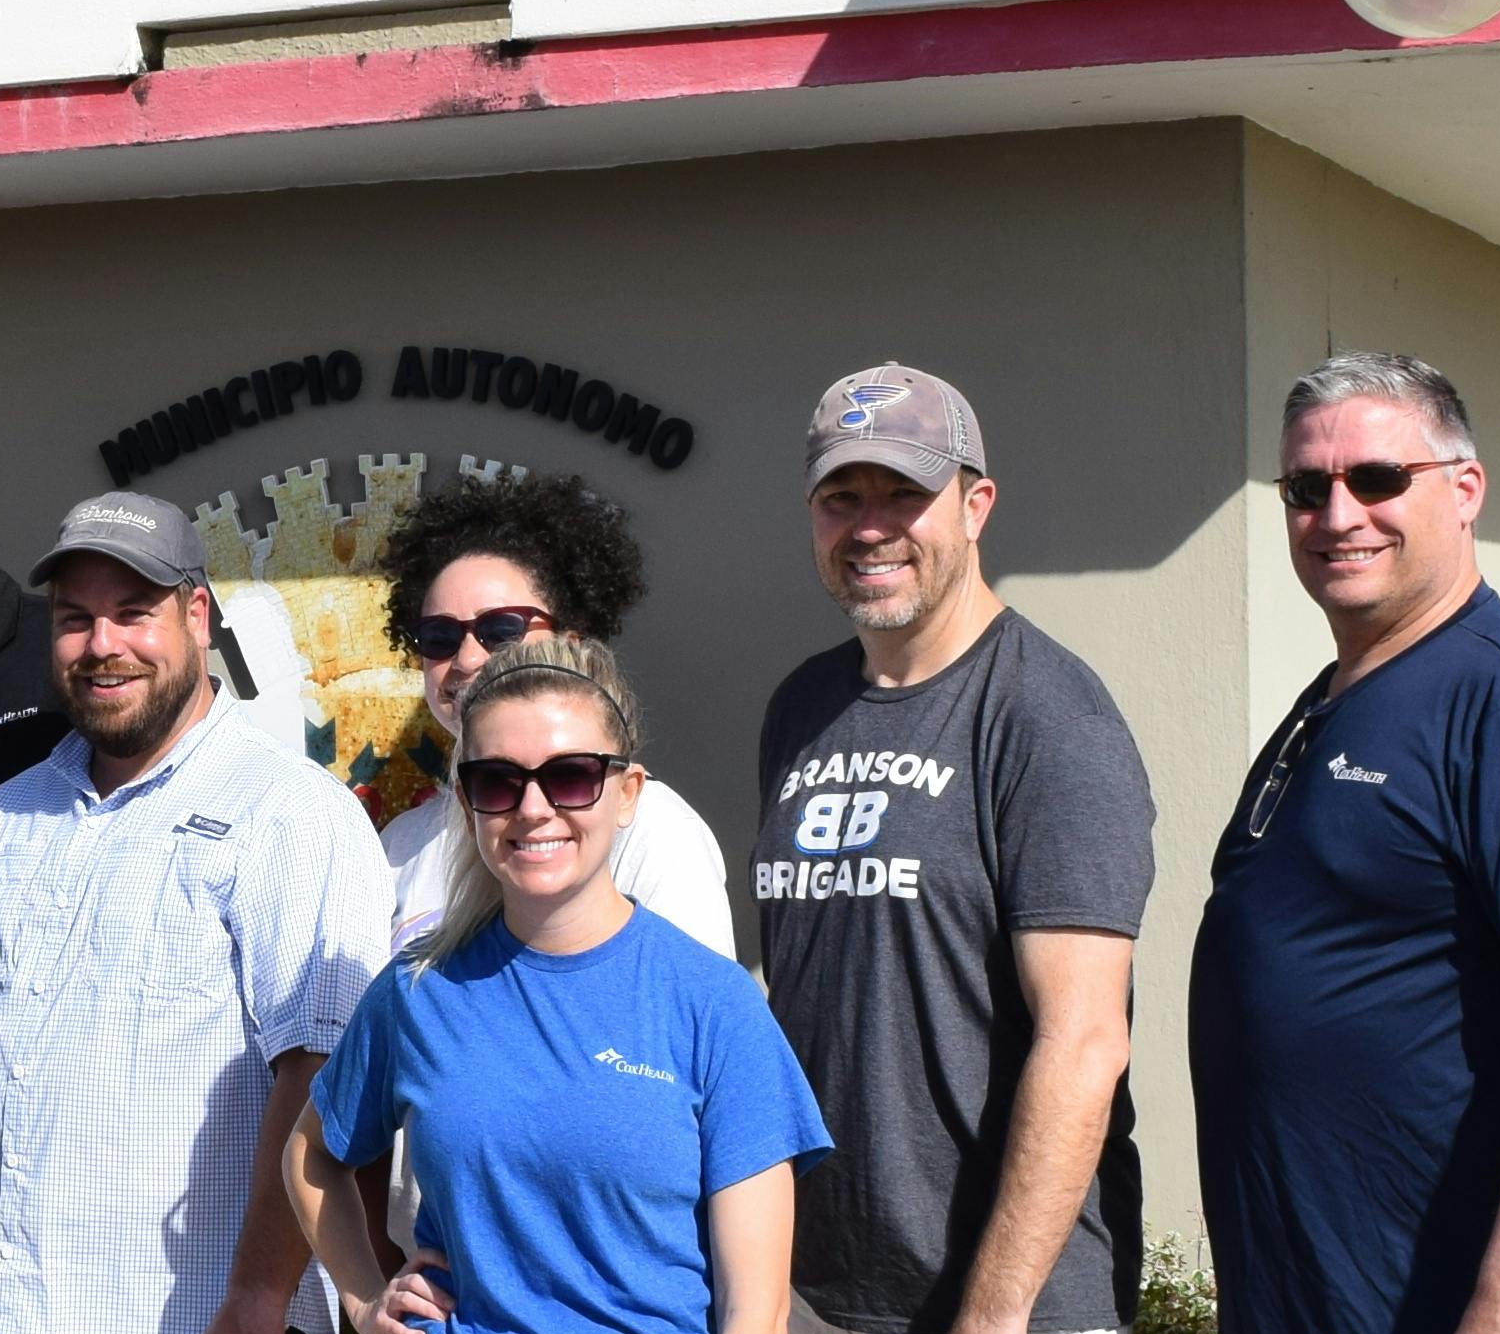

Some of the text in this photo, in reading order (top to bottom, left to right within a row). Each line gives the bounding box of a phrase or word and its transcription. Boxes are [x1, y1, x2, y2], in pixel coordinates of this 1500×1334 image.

[99, 346, 695, 487] MUNICIPIO AUTONOMO
[778, 751, 955, 804] BRANSON
[756, 857, 921, 900] BRIGADE
